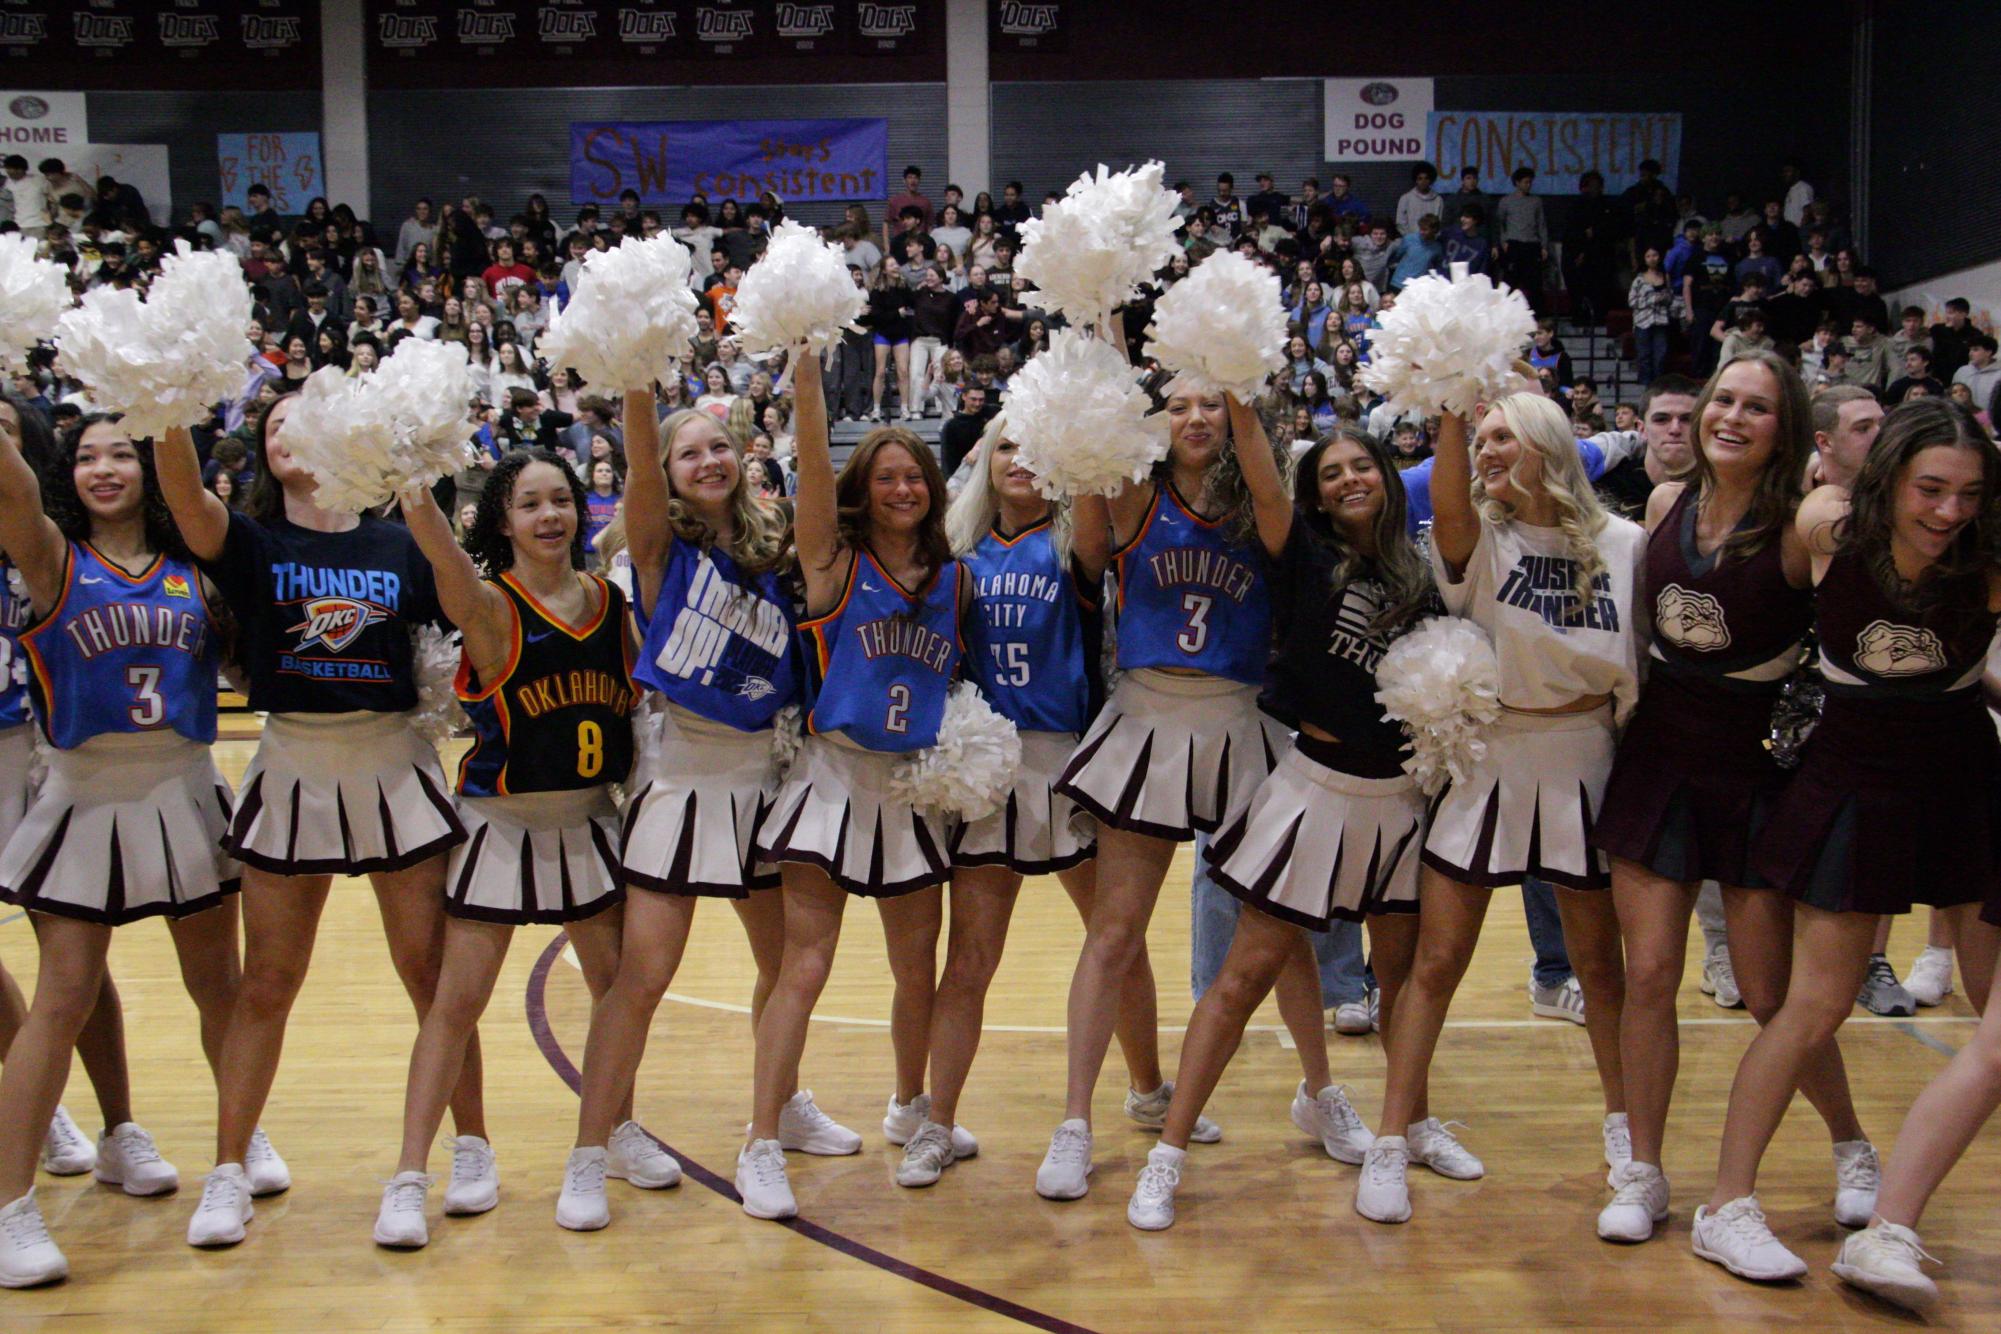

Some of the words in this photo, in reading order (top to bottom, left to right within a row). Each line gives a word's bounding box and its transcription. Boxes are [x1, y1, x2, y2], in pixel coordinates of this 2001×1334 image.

[0, 126, 68, 143] HOME
[1354, 112, 1404, 130] DOG
[247, 134, 286, 162] FOR
[583, 127, 668, 198] SW
[1337, 138, 1421, 155] POUND
[1436, 116, 1679, 179] CONSISTENT
[245, 164, 286, 190] THE
[693, 167, 877, 197] consistent
[272, 562, 400, 612] THUNDER
[973, 572, 1059, 603] LAHOMA
[1151, 550, 1255, 603] THUNDER
[1496, 569, 1620, 633] THUNDER
[66, 604, 208, 661] THUNDER
[304, 608, 356, 641] OKC
[857, 620, 951, 673] THUNDER
[1177, 592, 1214, 655] 3
[281, 655, 391, 679] BASKETBALL
[1327, 629, 1388, 674] THU
[128, 665, 165, 727] 3
[885, 684, 911, 733] 2
[577, 720, 603, 778] 8
